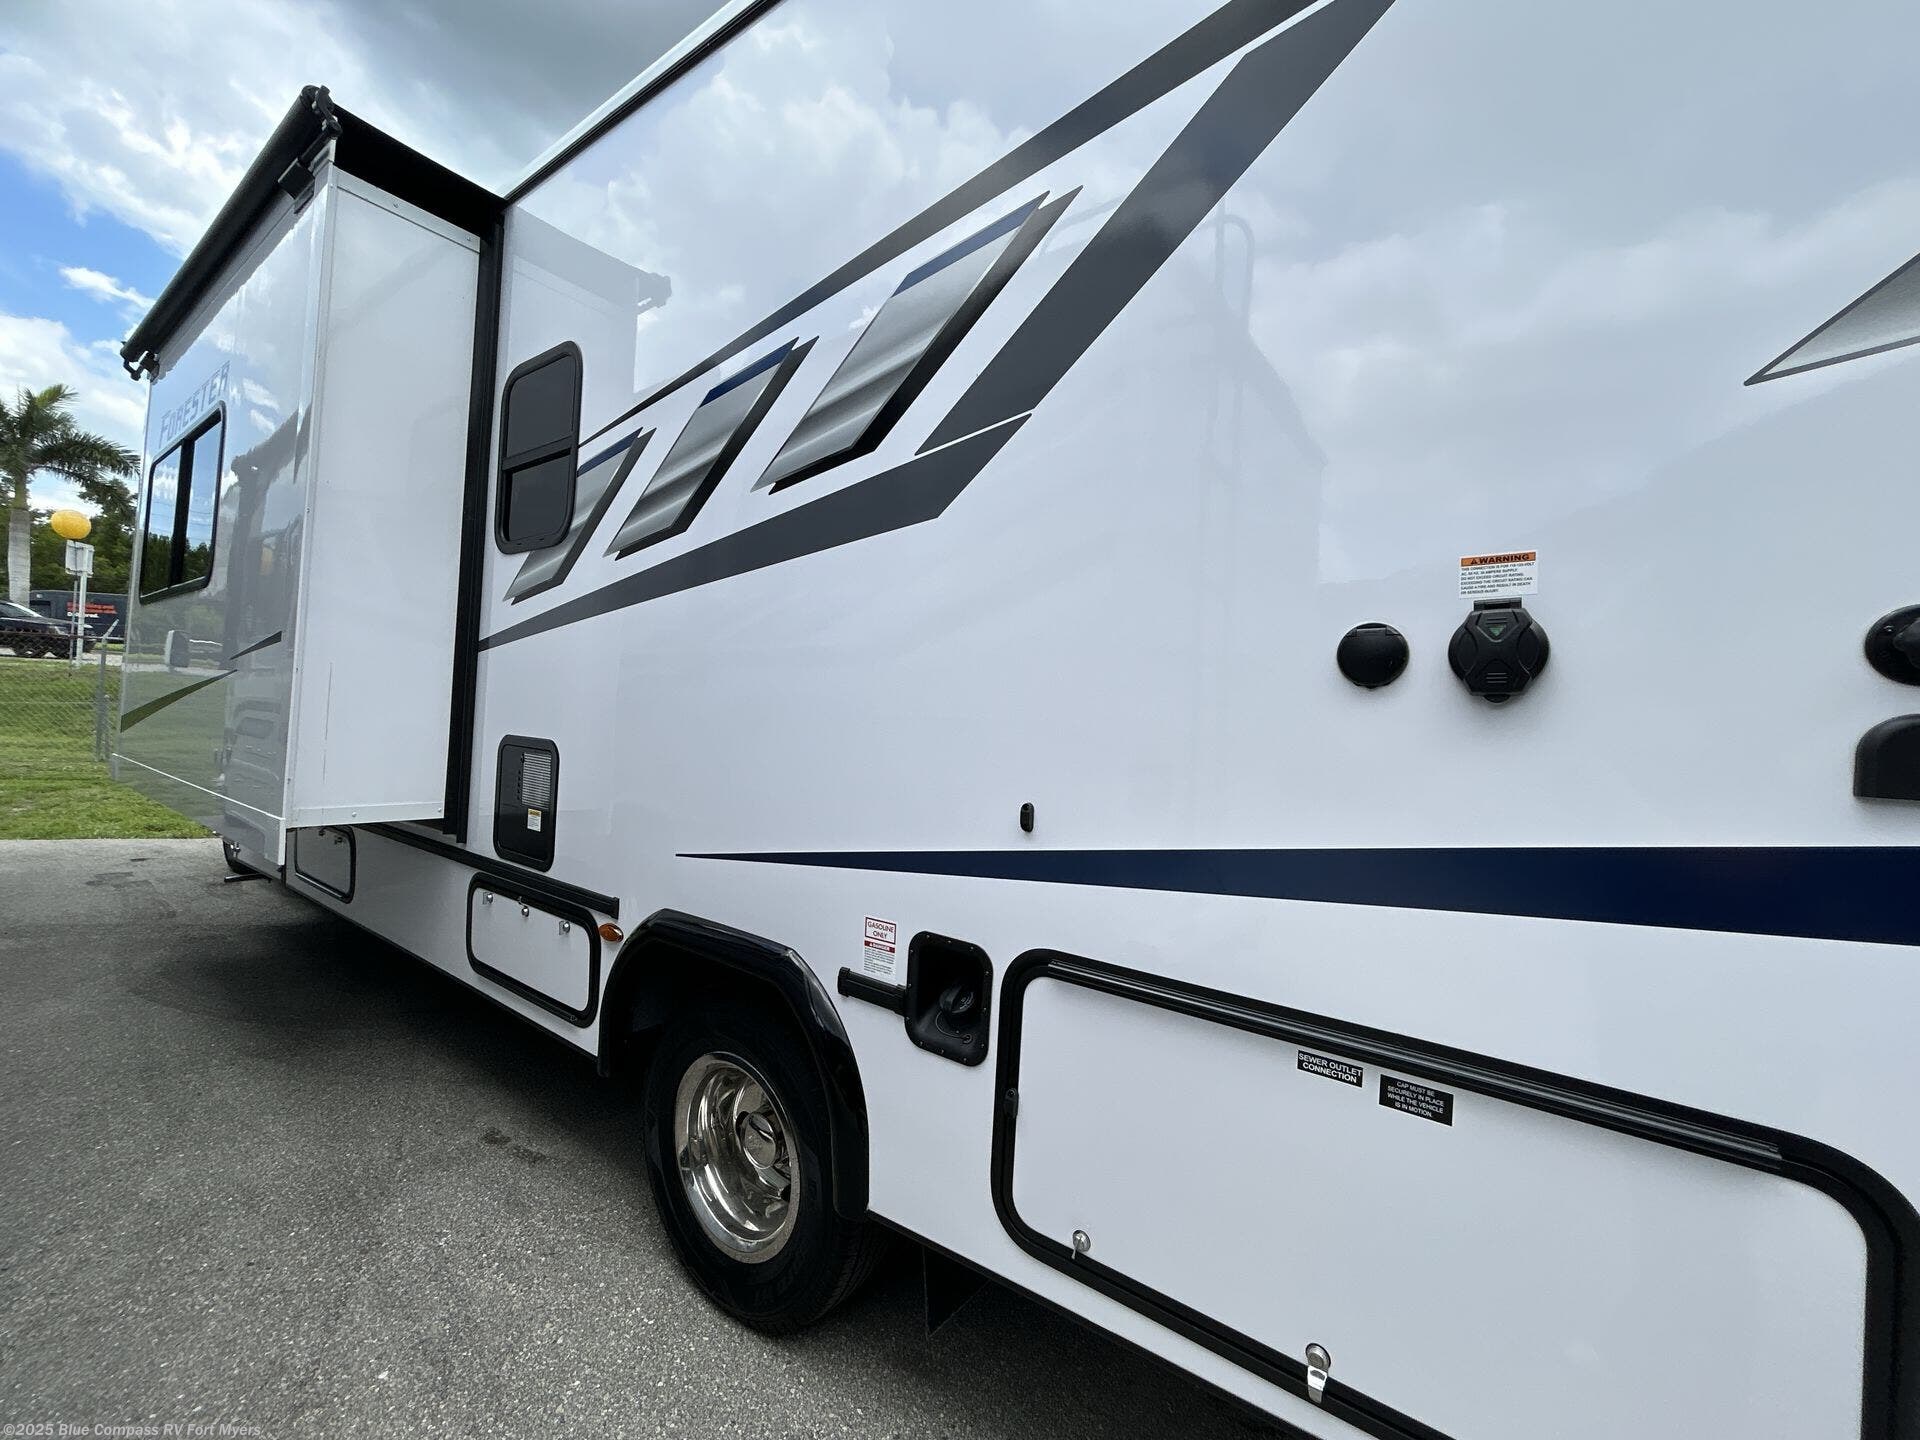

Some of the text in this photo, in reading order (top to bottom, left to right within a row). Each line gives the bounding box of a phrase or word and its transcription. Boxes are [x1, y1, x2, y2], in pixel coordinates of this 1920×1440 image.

[1480, 554, 1529, 564] WARNING
[868, 921, 894, 933] GASOLINE
[873, 931, 887, 939] ONLY
[1298, 1053, 1362, 1077] SEWER OUTLET
[1302, 1063, 1357, 1083] CONNECTION
[1387, 1086, 1417, 1098] SECURELY
[1425, 1095, 1444, 1107] PLACE
[1410, 1085, 1426, 1093] MUST
[1427, 1089, 1435, 1097] BE
[1387, 1093, 1444, 1114] WHILE THE VEHICLE
